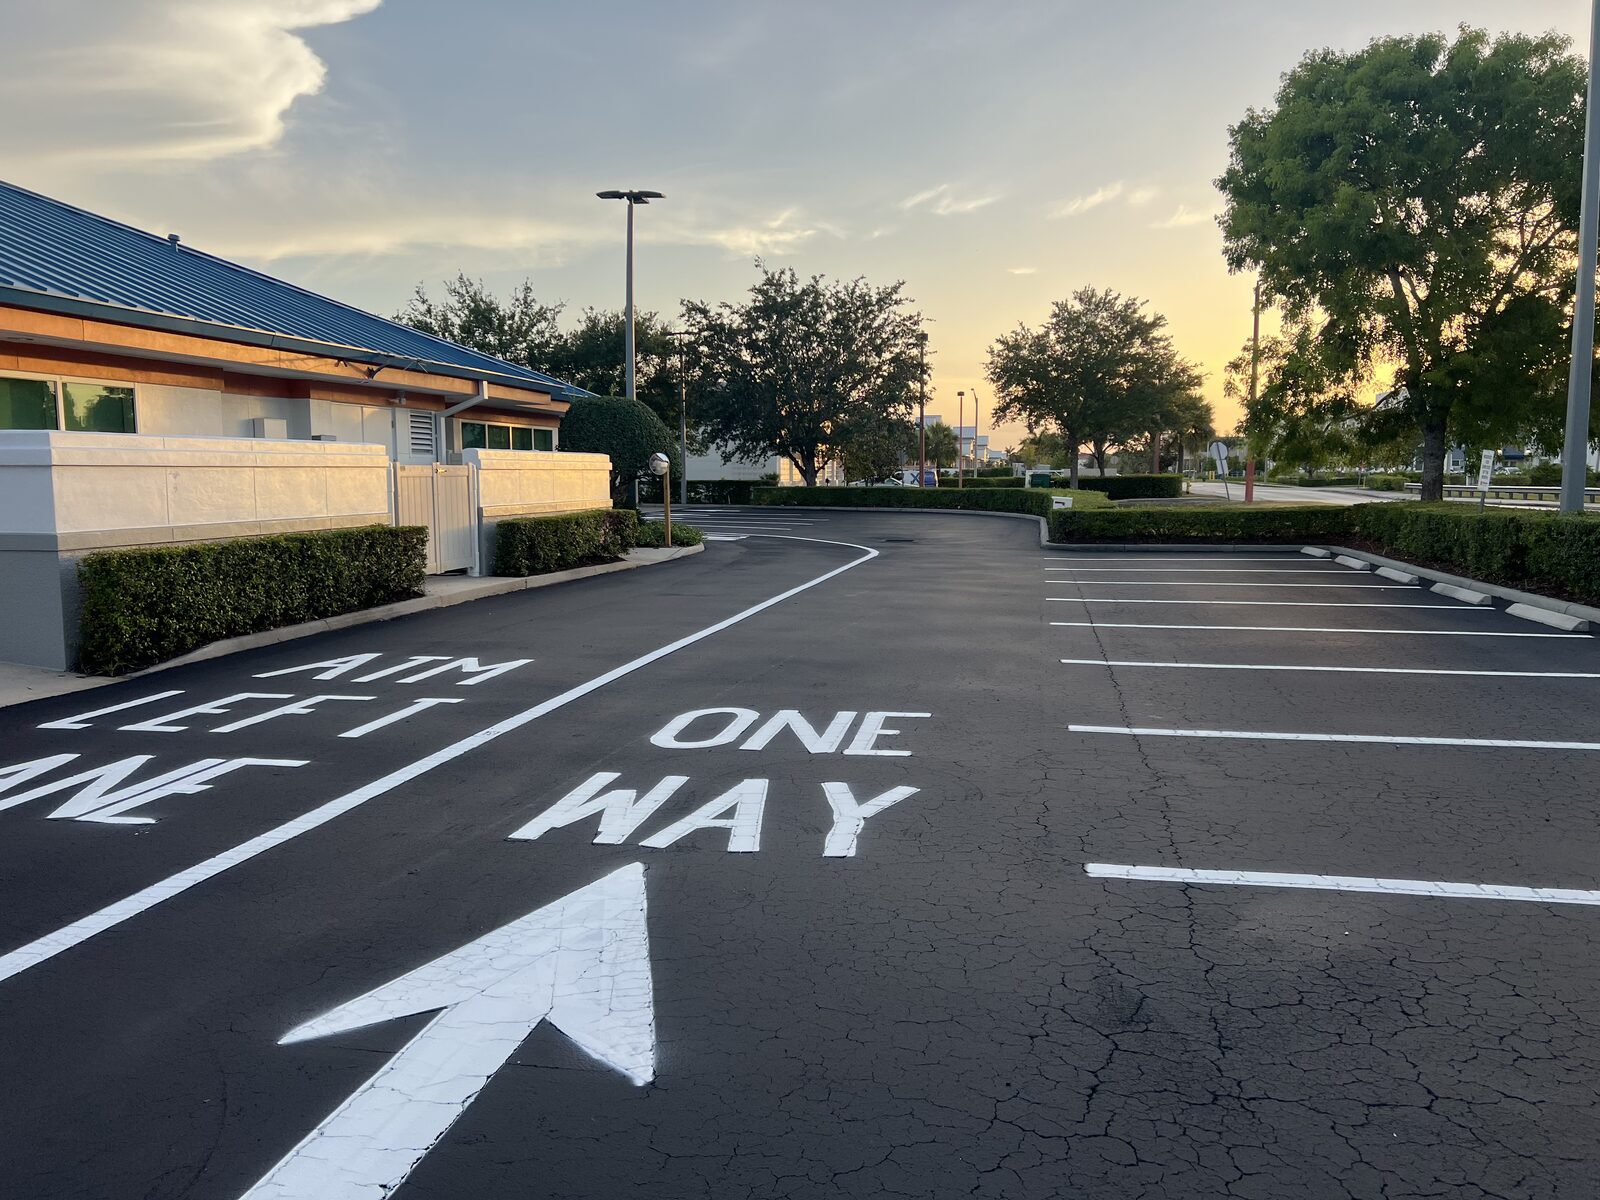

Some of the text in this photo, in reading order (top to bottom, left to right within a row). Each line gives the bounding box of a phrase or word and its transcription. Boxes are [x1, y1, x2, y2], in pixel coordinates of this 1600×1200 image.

[251, 652, 535, 686] ATM
[36, 690, 466, 738] LEFT
[649, 707, 933, 757] ONE
[506, 771, 921, 858] WAY
